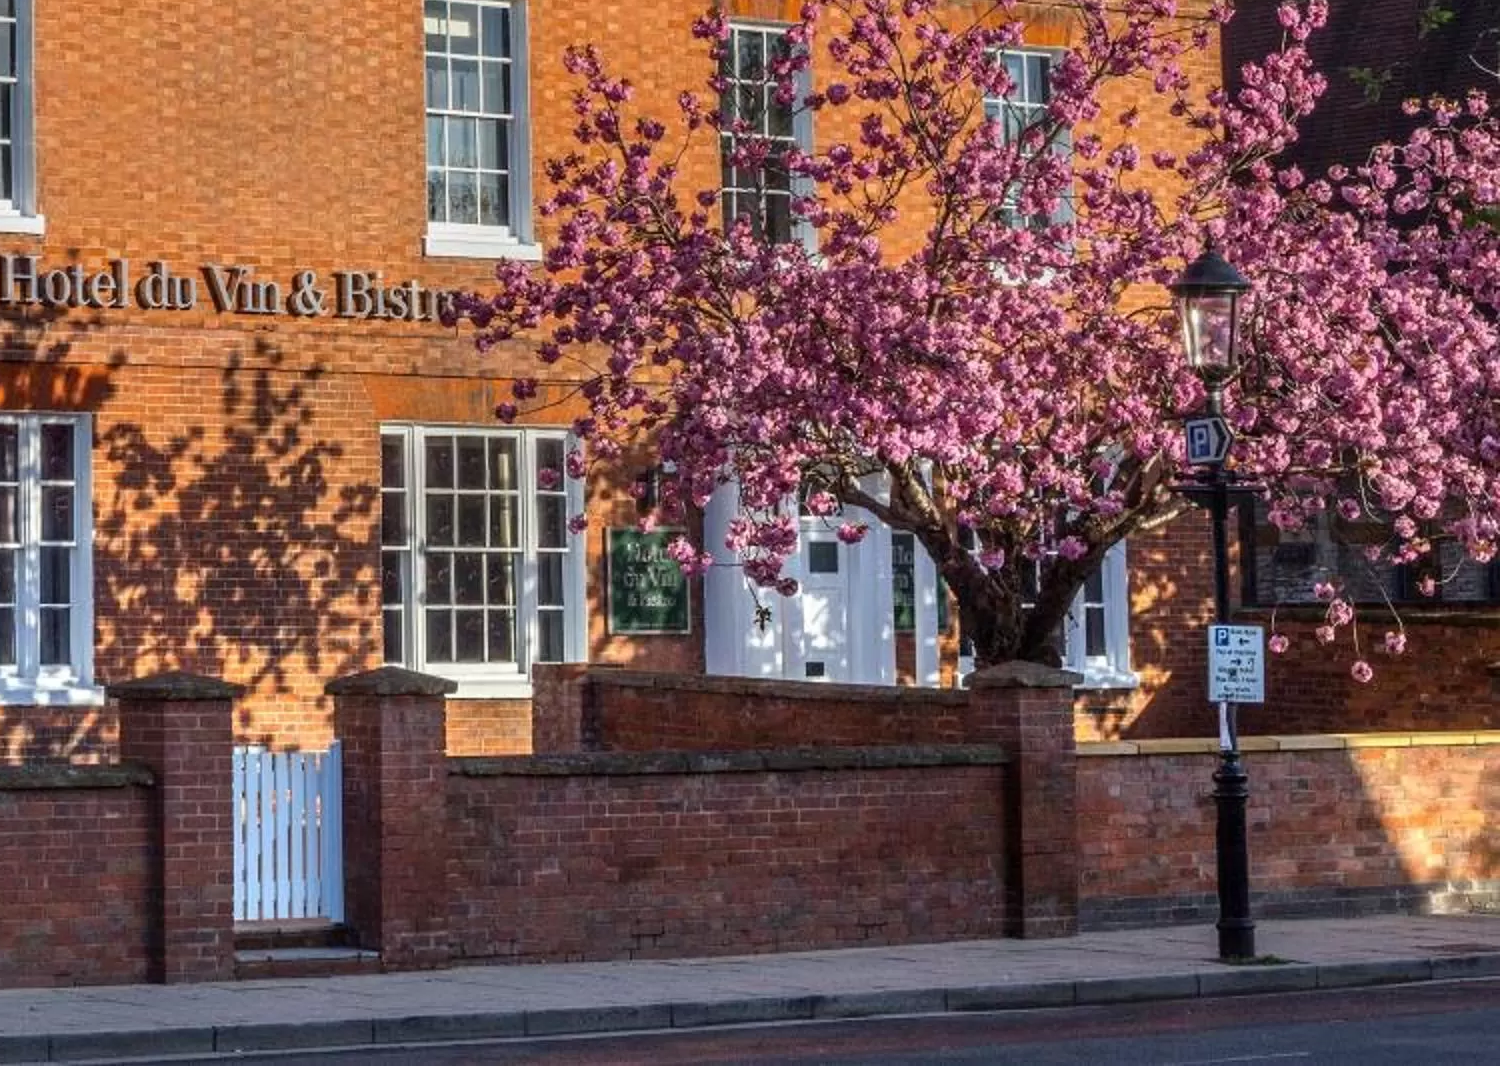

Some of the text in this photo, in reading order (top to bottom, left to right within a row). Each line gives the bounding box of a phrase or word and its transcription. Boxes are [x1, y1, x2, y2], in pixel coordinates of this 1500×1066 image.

[137, 260, 196, 310] du
[201, 261, 288, 314] Vin
[288, 269, 329, 317] &
[332, 268, 457, 321] Bistr
[1193, 427, 1208, 458] P
